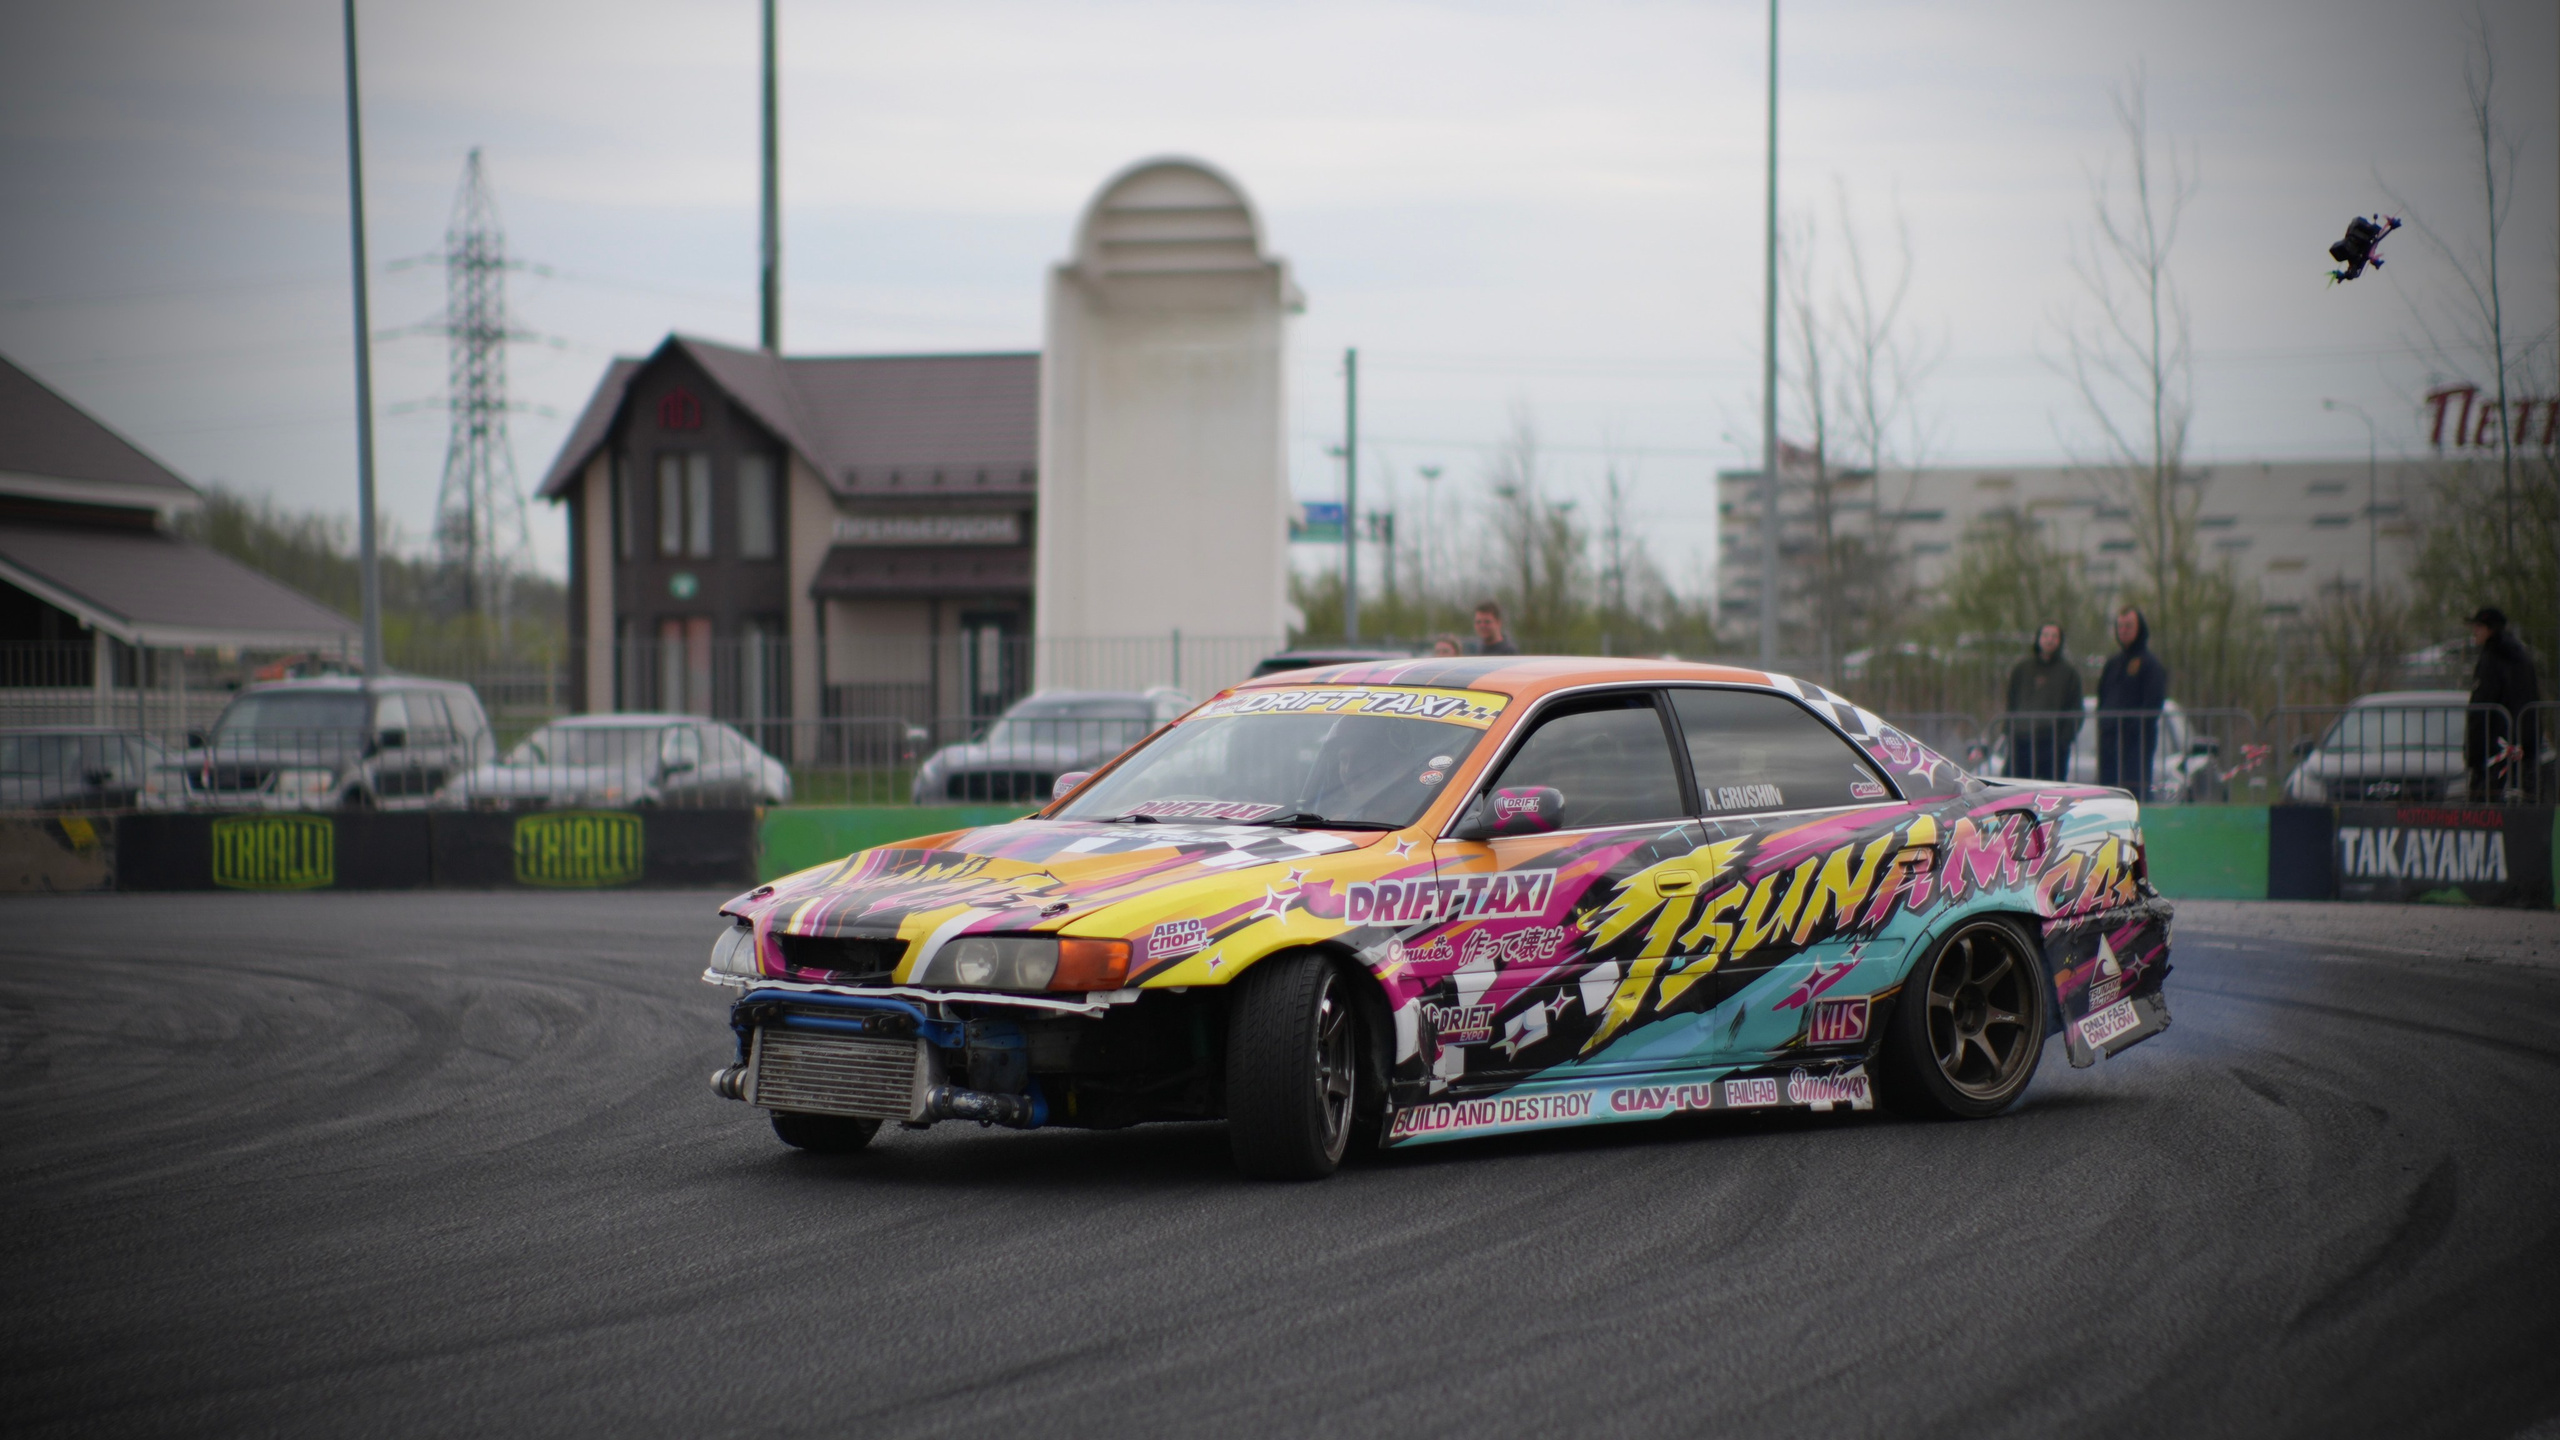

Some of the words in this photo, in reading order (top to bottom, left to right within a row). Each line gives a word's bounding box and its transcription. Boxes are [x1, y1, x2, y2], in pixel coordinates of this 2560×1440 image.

[1235, 691, 1369, 713] DRIFT
[1360, 692, 1461, 718] TAXI
[1123, 801, 1211, 816] DRIFT
[1196, 803, 1280, 820] TAXI
[1508, 798, 1538, 807] DRIFT
[2462, 809, 2504, 827] МАСЛА
[219, 819, 328, 882] TRIALLI
[525, 819, 635, 879] TRIALLI
[2339, 827, 2508, 882] TAKAYAMA
[1348, 878, 1460, 922] DRIFT
[1462, 873, 1552, 916] TAXI
[1149, 930, 1205, 951] СПОРТ
[1154, 919, 1199, 937] АВТО
[2090, 979, 2120, 999] TSUNAMI
[2090, 990, 2119, 1009] FACTORY
[1438, 1005, 1494, 1031] DRIFT
[1816, 1003, 1866, 1040] VHS
[2083, 1013, 2106, 1033] ONLY
[2107, 1000, 2131, 1021] FAST
[2088, 1023, 2112, 1043] ONLY
[2112, 1011, 2135, 1031] LOW
[1460, 1031, 1484, 1041] EXPO
[1789, 1066, 1868, 1104] Smokers
[1393, 1102, 1450, 1134] BUILD
[1454, 1100, 1497, 1127] AND
[1500, 1092, 1593, 1122] DESTROY
